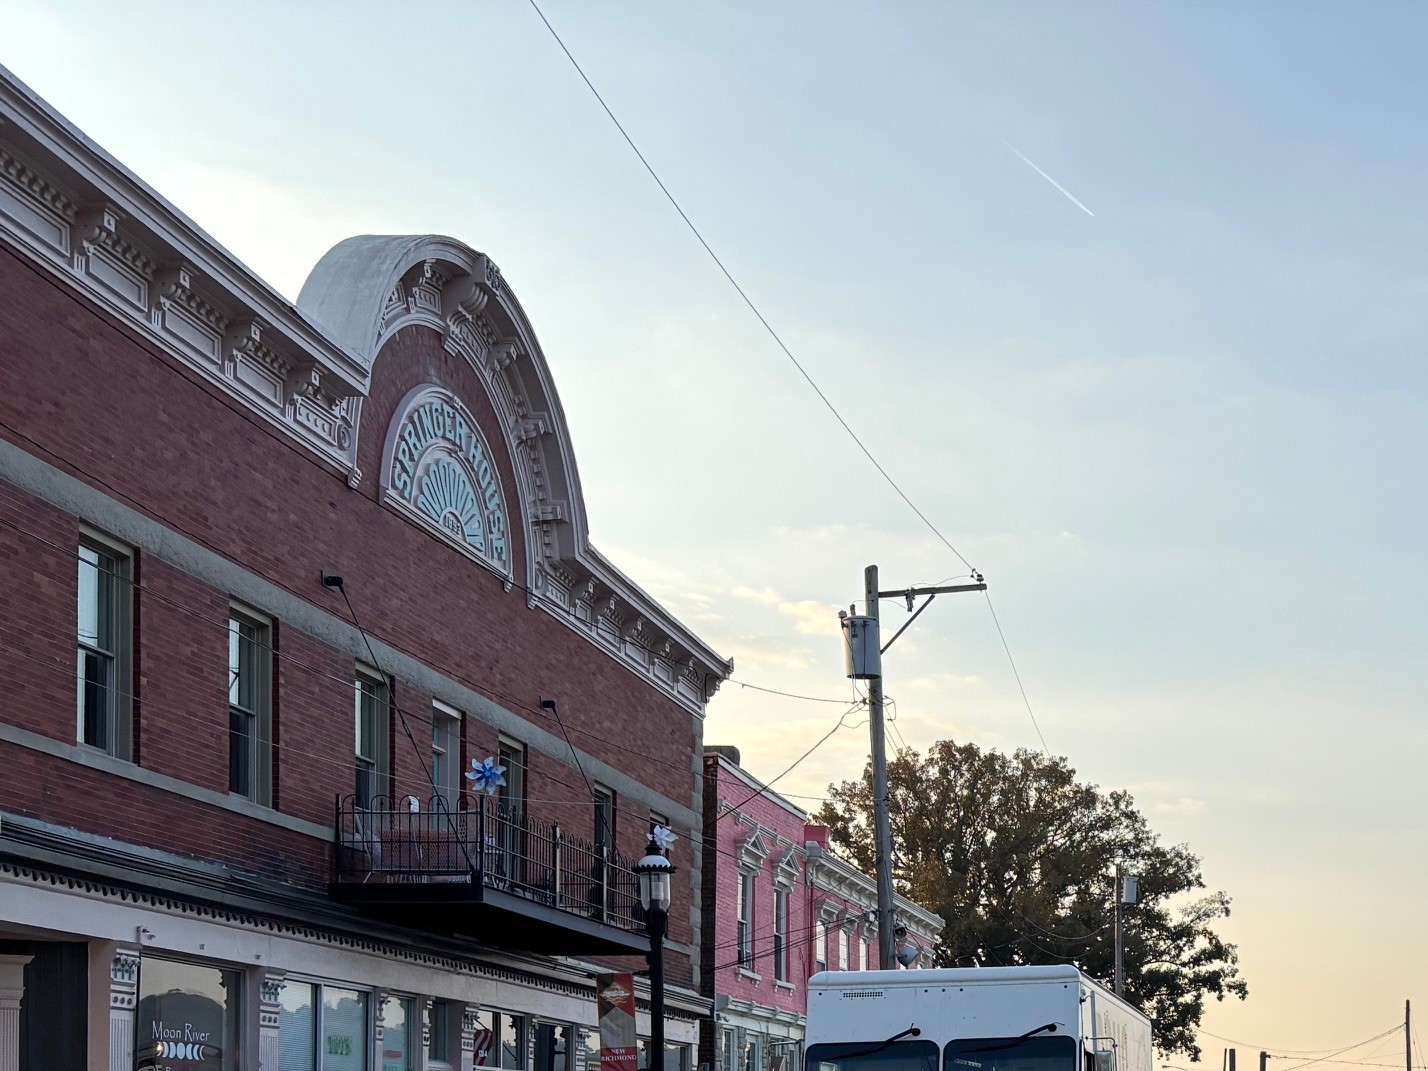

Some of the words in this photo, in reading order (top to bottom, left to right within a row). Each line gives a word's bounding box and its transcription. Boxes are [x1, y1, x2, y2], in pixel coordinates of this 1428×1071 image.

[393, 401, 471, 500] SPRINGER
[470, 432, 507, 561] HOUSE
[152, 1020, 181, 1040] Moon
[184, 1023, 210, 1041] River
[601, 1054, 637, 1062] RICHMOND
